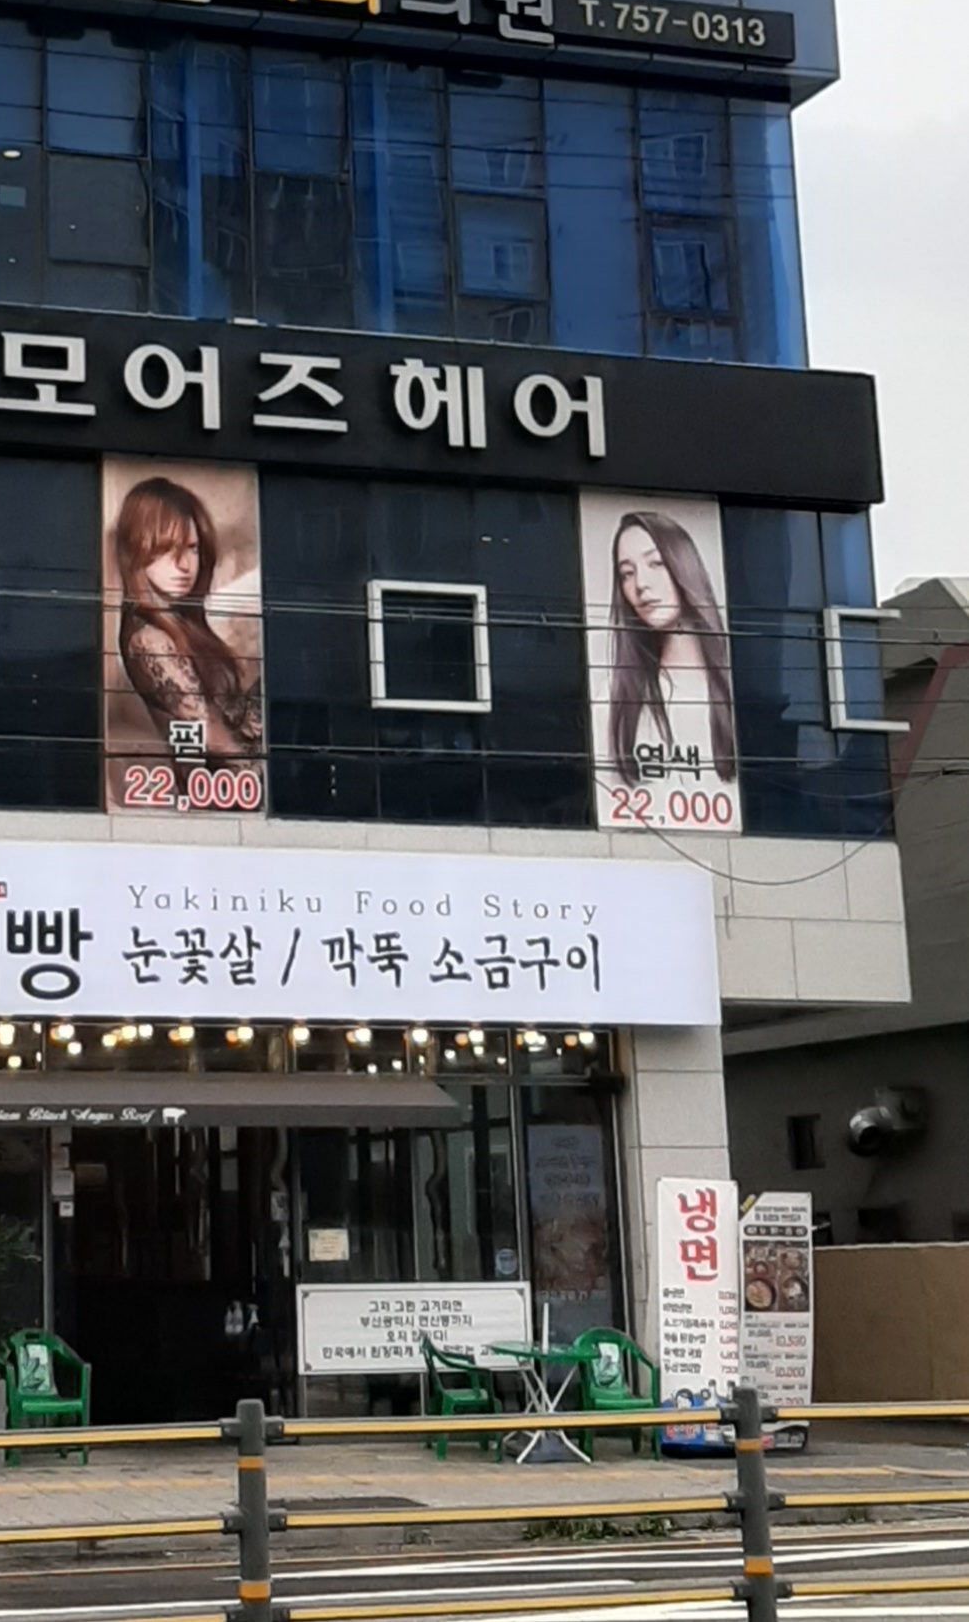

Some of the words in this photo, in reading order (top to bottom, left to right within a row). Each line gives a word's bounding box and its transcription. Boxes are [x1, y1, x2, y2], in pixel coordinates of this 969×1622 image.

[169, 720, 207, 764] 펌
[635, 742, 701, 782] 염색
[124, 764, 263, 812] 22,000
[611, 786, 734, 825] 22,000
[128, 884, 324, 915] Yakiniku
[355, 889, 453, 919] Food
[483, 893, 601, 925] Story
[122, 925, 262, 987] 눈꽃살
[320, 930, 410, 989] 깍뚝
[429, 933, 604, 993] 소금구이
[26, 1105, 69, 1121] Black
[71, 1107, 115, 1125] Angus
[676, 1186, 720, 1284] 냉면
